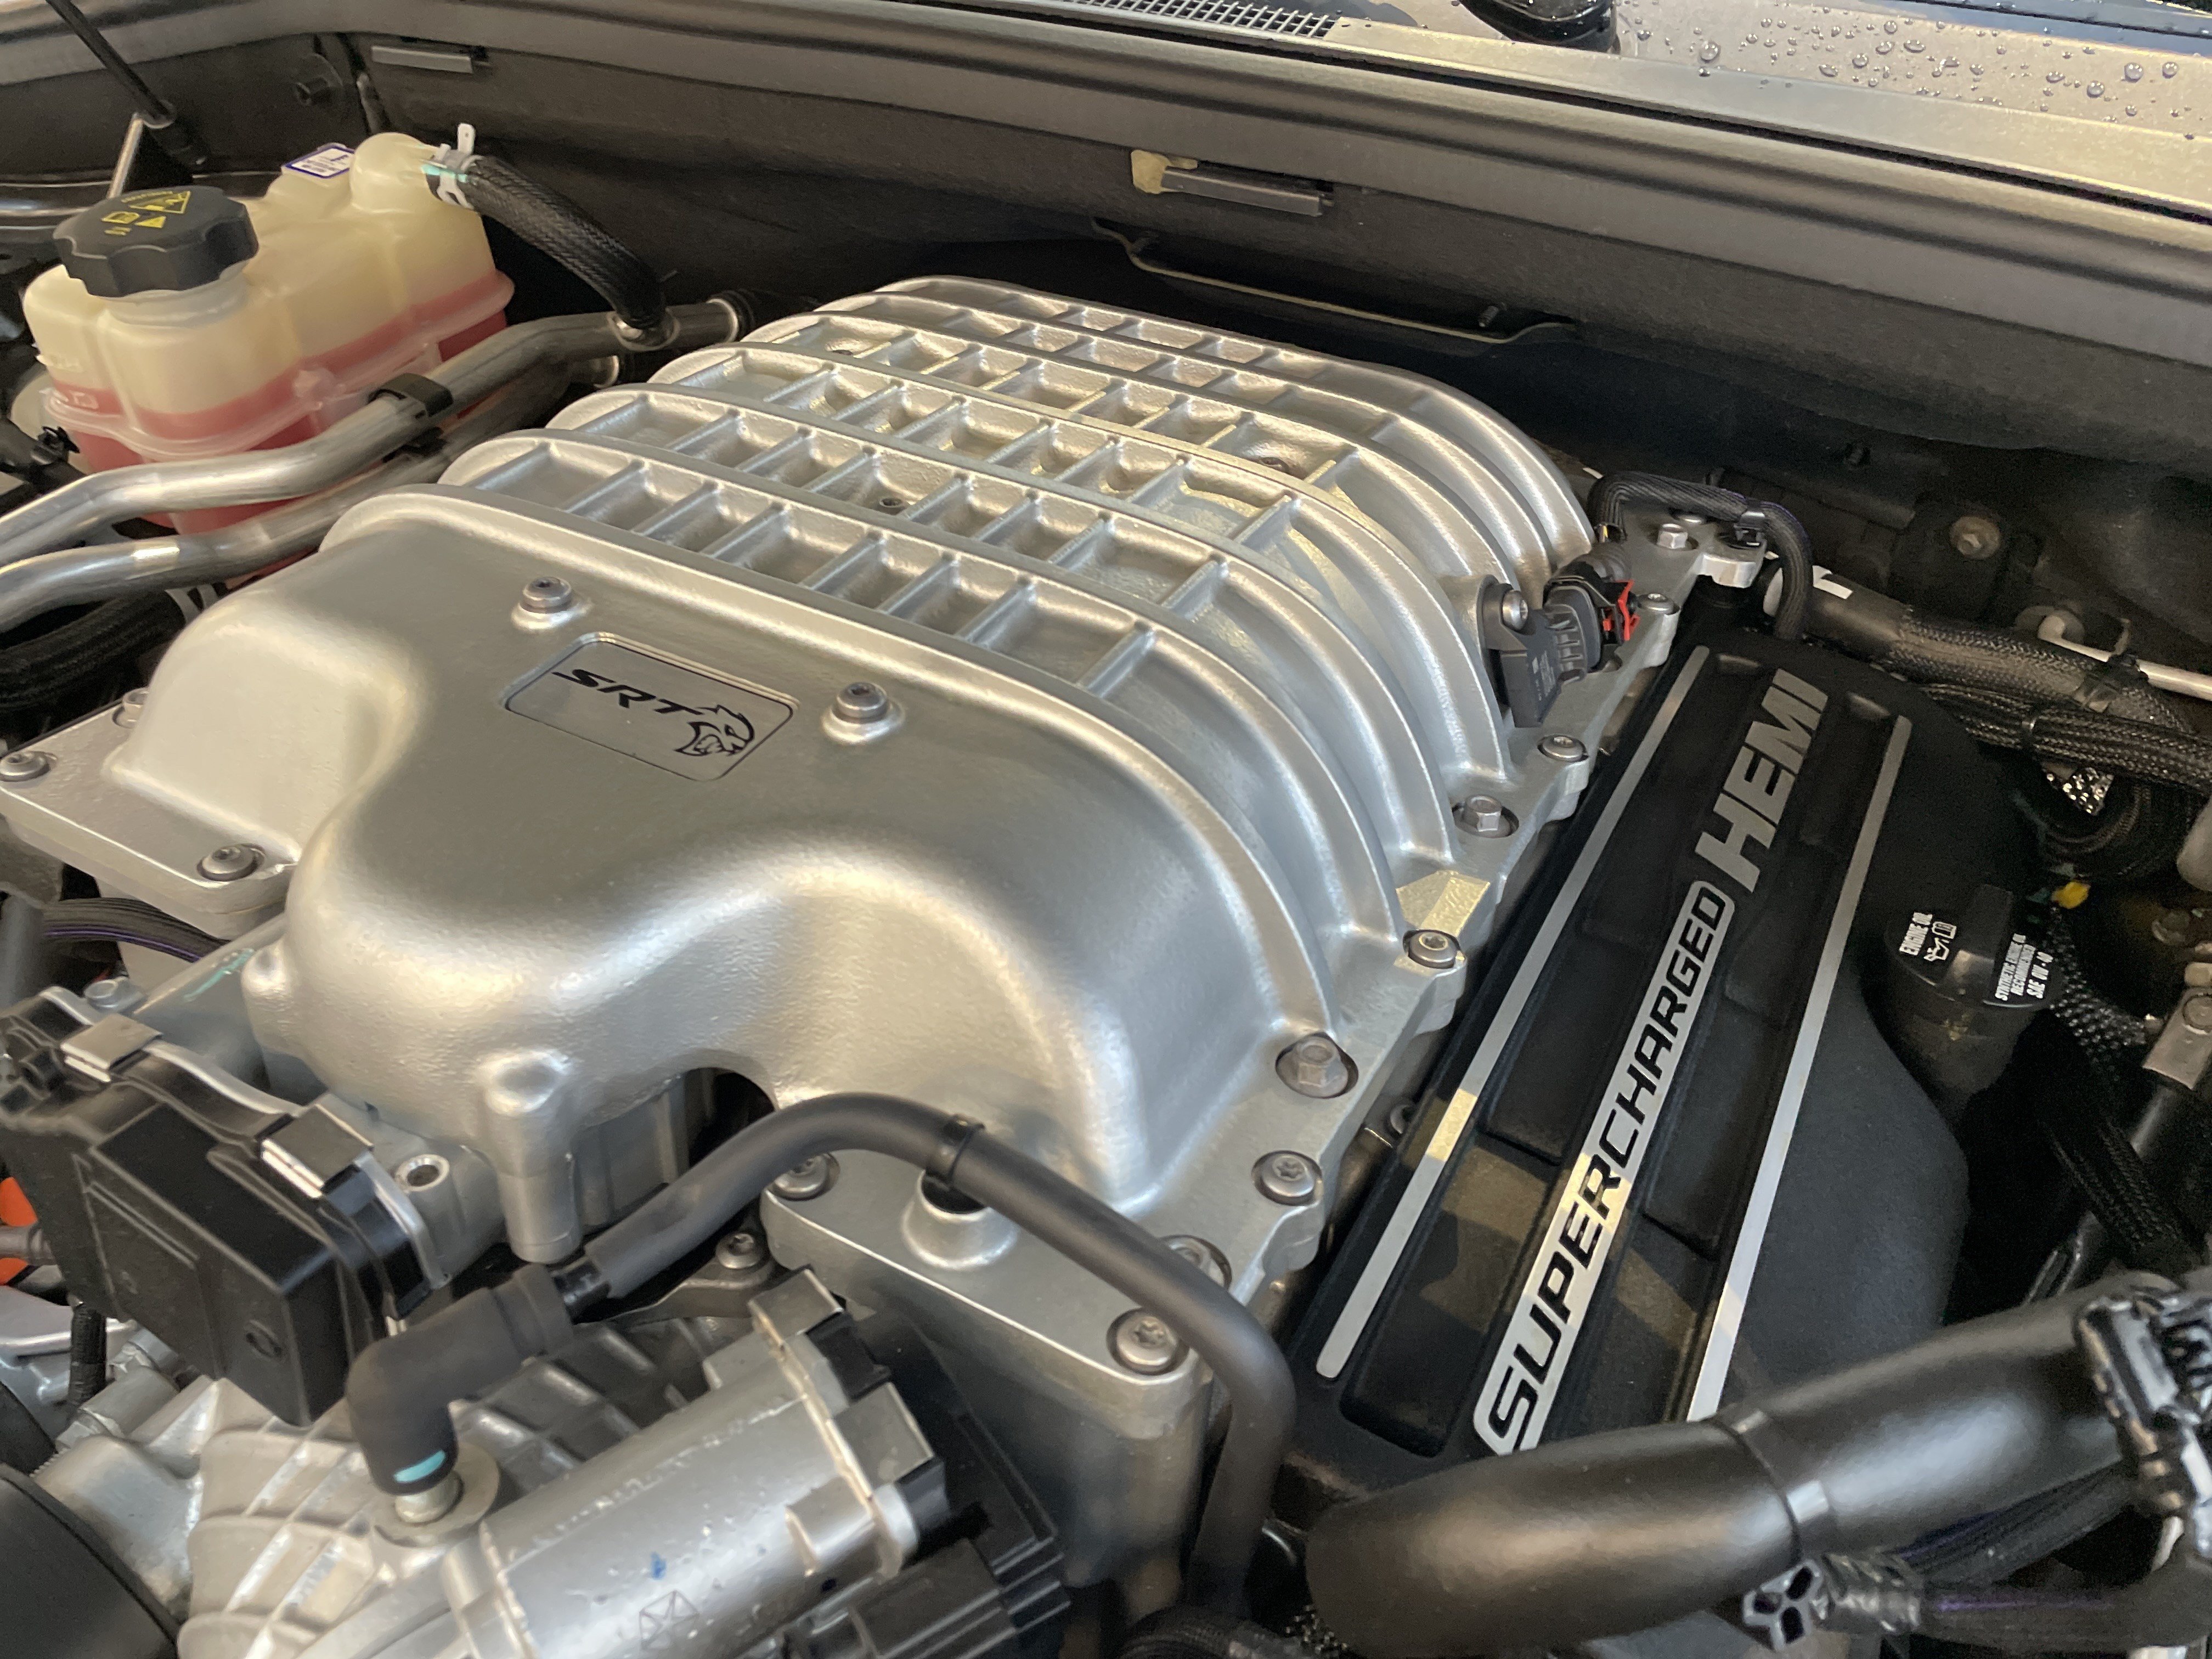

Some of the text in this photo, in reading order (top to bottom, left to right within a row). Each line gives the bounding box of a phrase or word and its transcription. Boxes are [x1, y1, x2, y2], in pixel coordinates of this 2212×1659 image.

[552, 668, 706, 715] SRT
[1899, 911, 1932, 955] ENGINE OIL
[1995, 962, 2016, 1001] SYNTHETIC
[2010, 944, 2036, 996] RECOMMENDED
[2026, 979, 2045, 998] SAE
[1488, 668, 1828, 1452] SUPERCHARGED HEMI
